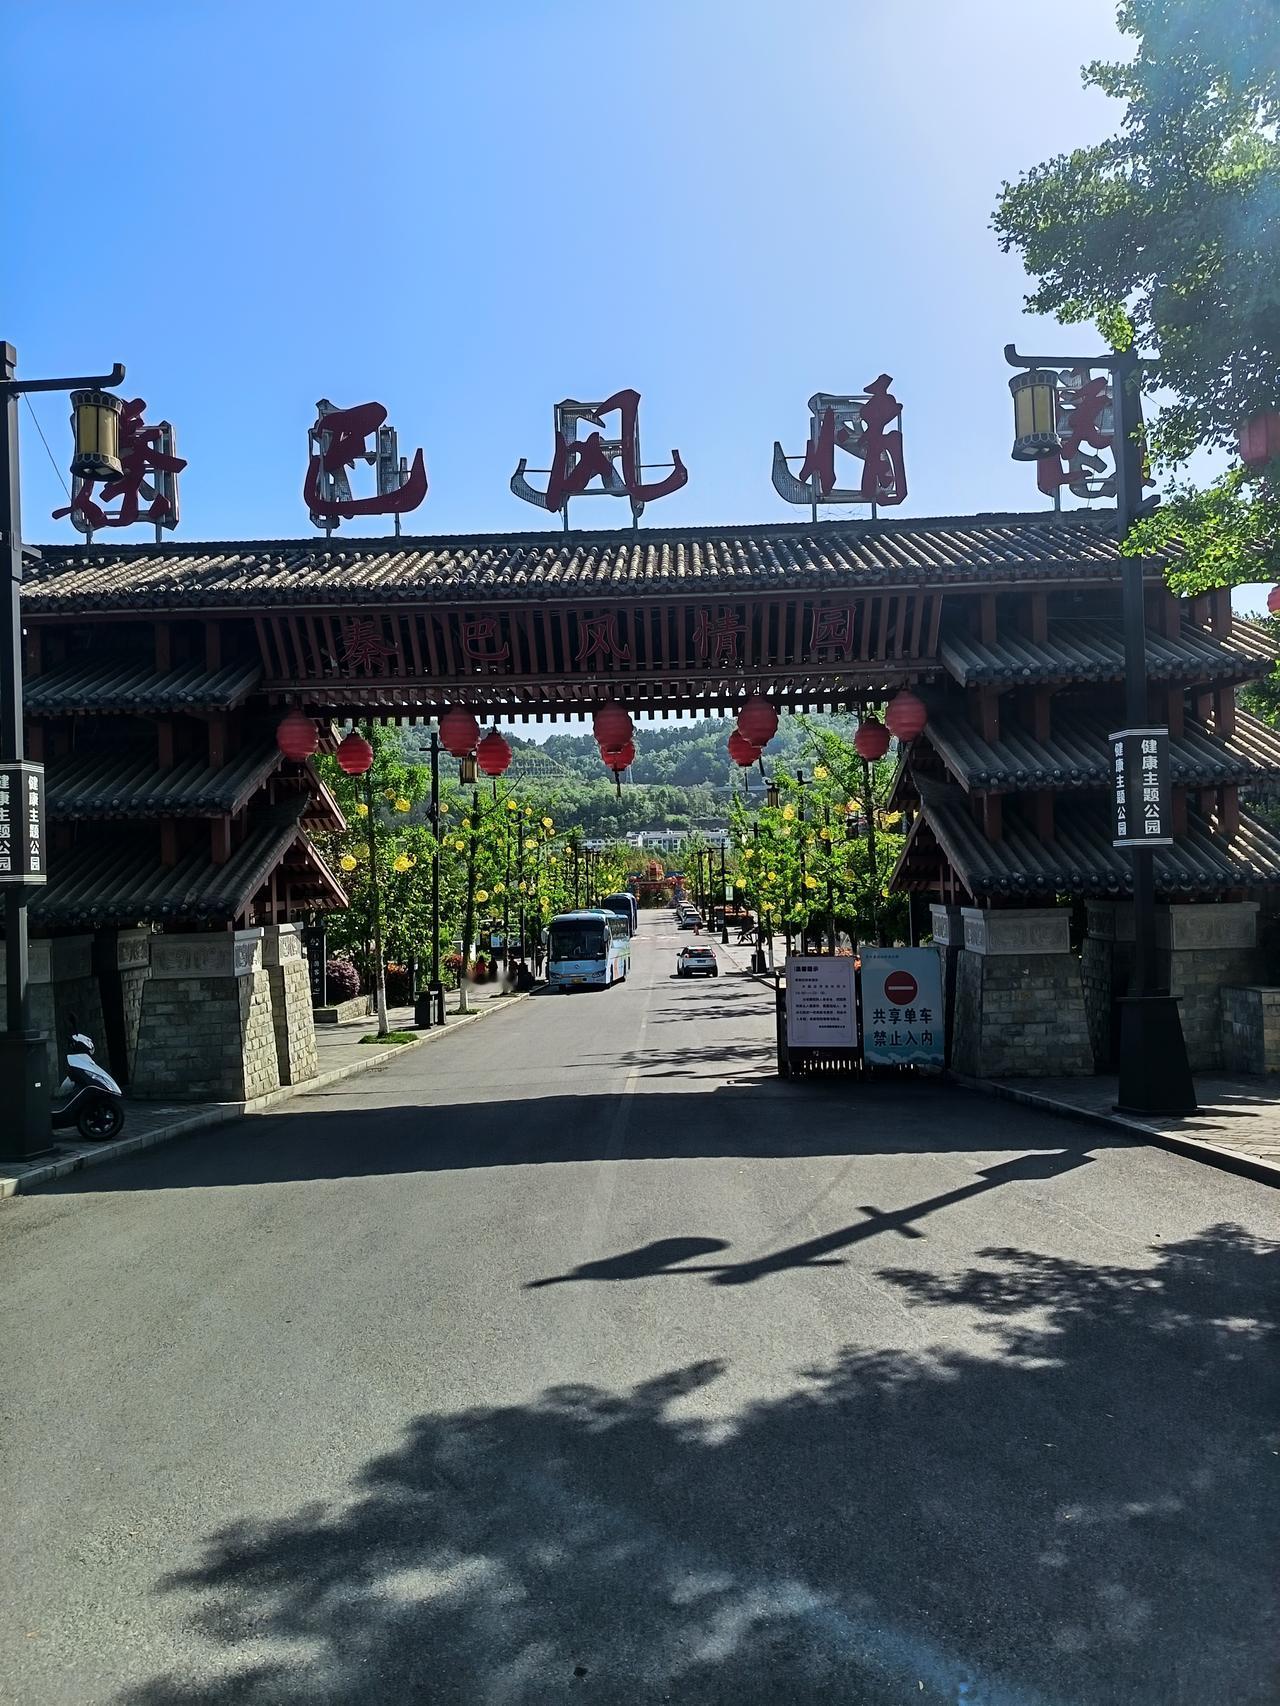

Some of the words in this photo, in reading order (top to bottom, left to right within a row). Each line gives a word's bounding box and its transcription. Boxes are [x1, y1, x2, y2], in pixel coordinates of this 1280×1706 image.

[339, 602, 857, 671] 秦巴风情园
[28, 775, 40, 871] 健康主题公园
[1114, 742, 1127, 836] 健康主题公园
[1141, 739, 1160, 835] 健康主题公园
[873, 1007, 933, 1025] 共享单车
[873, 1030, 933, 1047] 禁止入内
